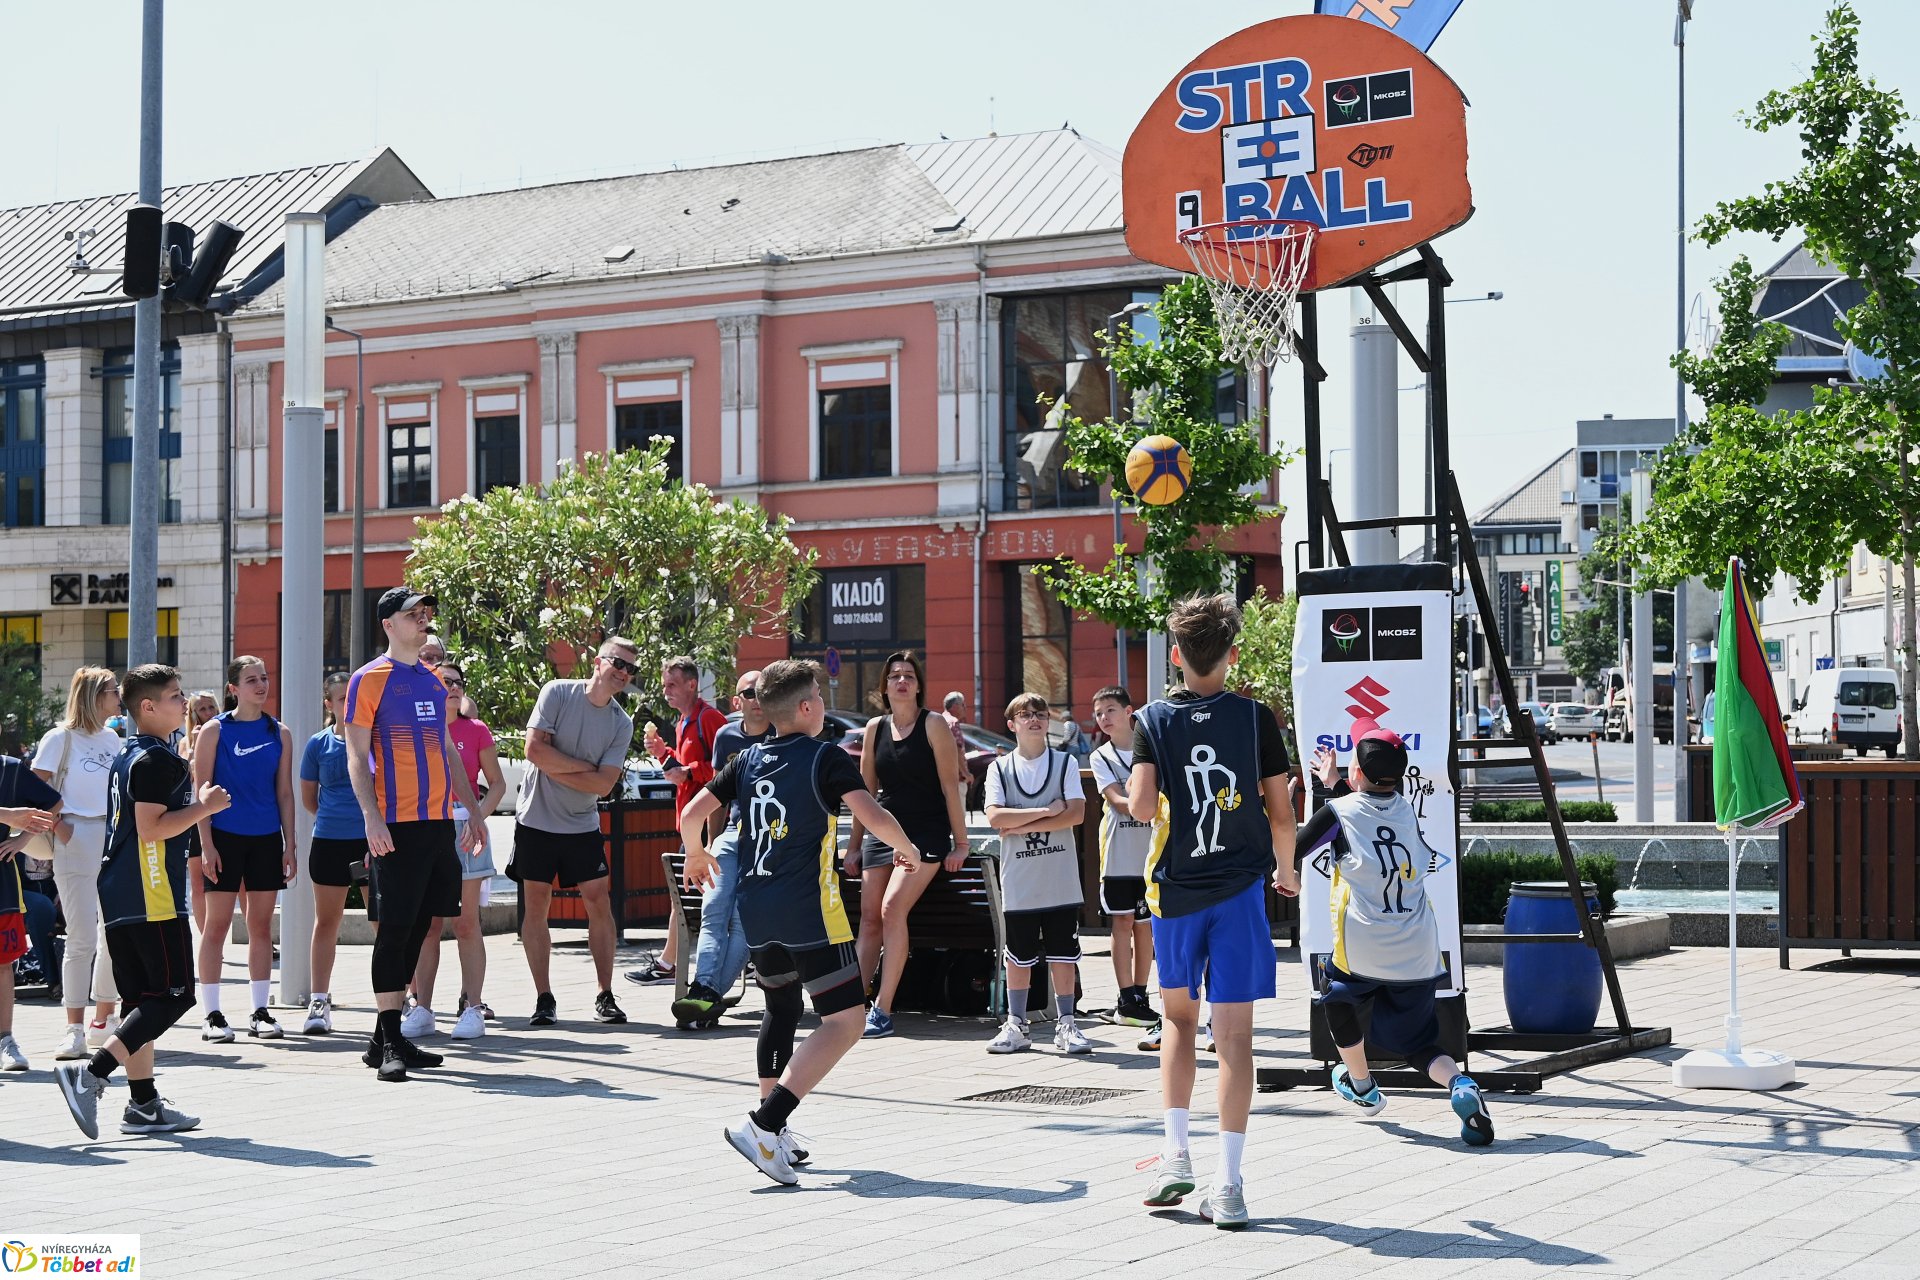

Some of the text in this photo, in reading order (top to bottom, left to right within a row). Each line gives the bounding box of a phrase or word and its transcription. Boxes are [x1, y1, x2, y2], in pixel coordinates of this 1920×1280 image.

[1373, 90, 1407, 101] MKOSZ
[1355, 144, 1395, 164] TOTI
[1223, 167, 1412, 242] BALL
[1178, 194, 1200, 235] 9
[1359, 317, 1371, 325] 36
[88, 589, 130, 605] BAN
[1549, 563, 1561, 642] PALEO
[1377, 628, 1417, 637] MKOSZ
[1316, 733, 1421, 752] SUKI
